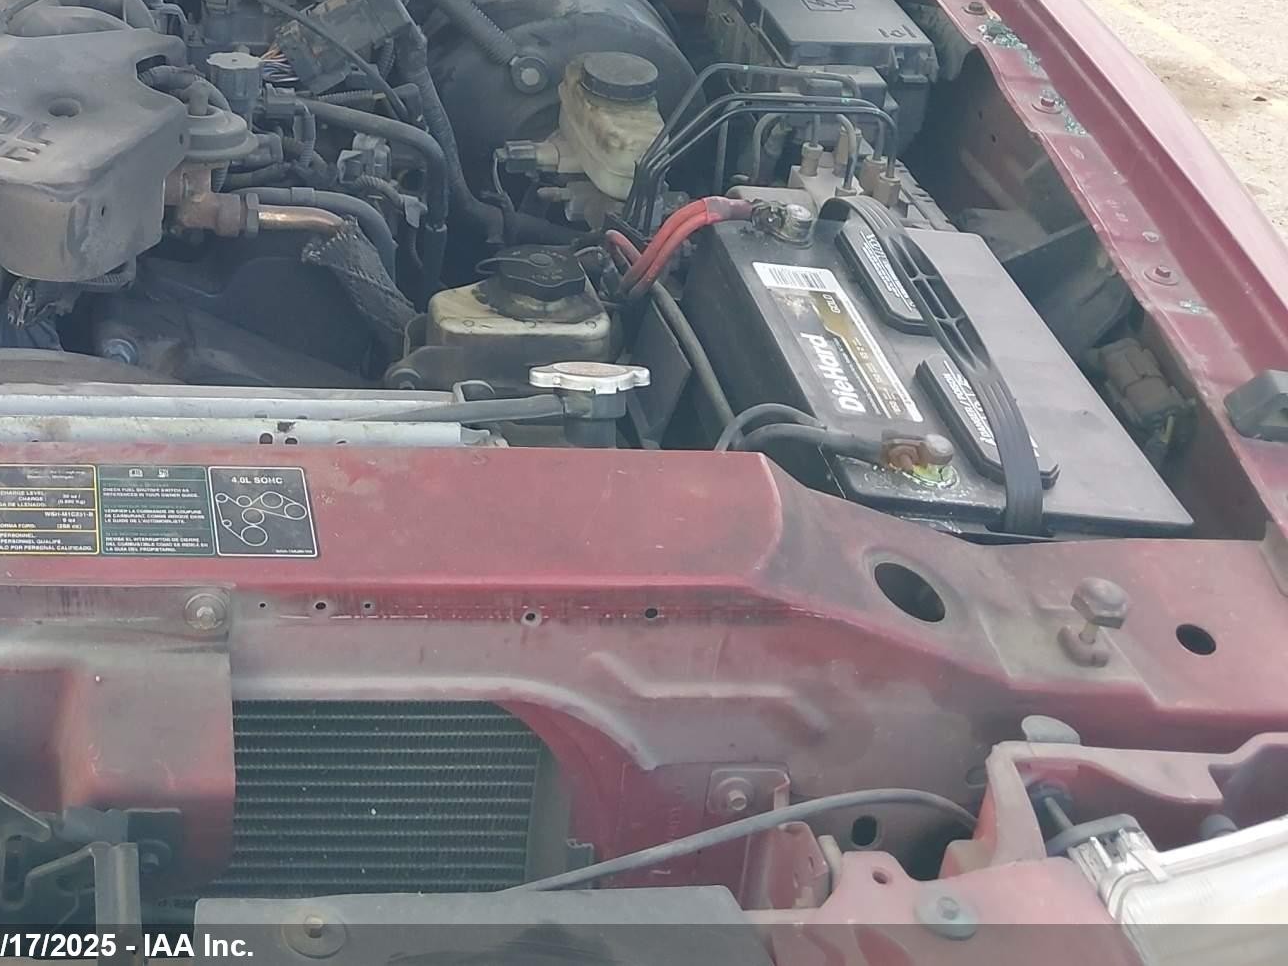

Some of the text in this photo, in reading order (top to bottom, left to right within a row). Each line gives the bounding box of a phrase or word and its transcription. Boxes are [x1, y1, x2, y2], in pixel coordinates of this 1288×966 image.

[800, 331, 866, 413] DieHard
[231, 476, 283, 484] 4.0L SOHC
